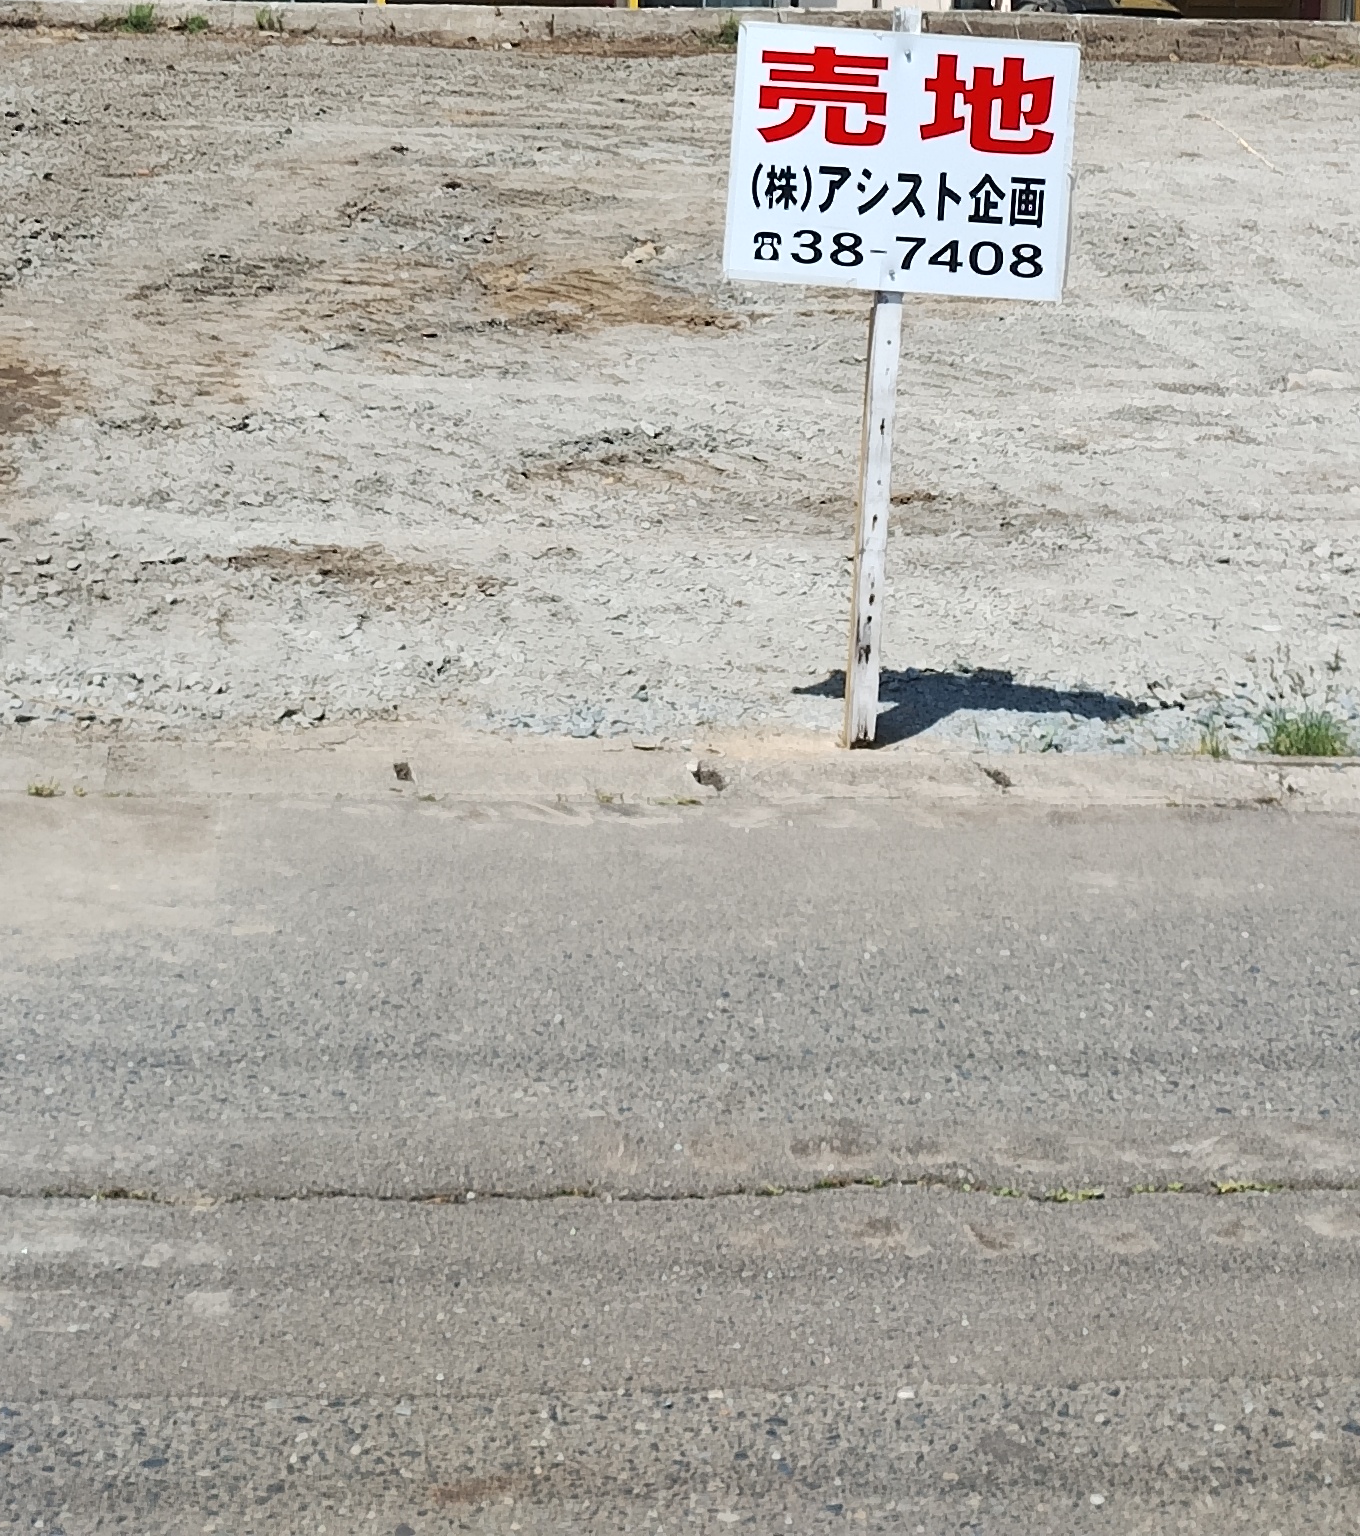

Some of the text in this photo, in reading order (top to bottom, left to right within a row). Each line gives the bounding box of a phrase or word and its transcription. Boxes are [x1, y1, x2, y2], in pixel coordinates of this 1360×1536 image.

[757, 46, 1055, 155] 売地
[751, 163, 1046, 229] (株)アシスト企画
[790, 229, 1044, 279] 38-7408
